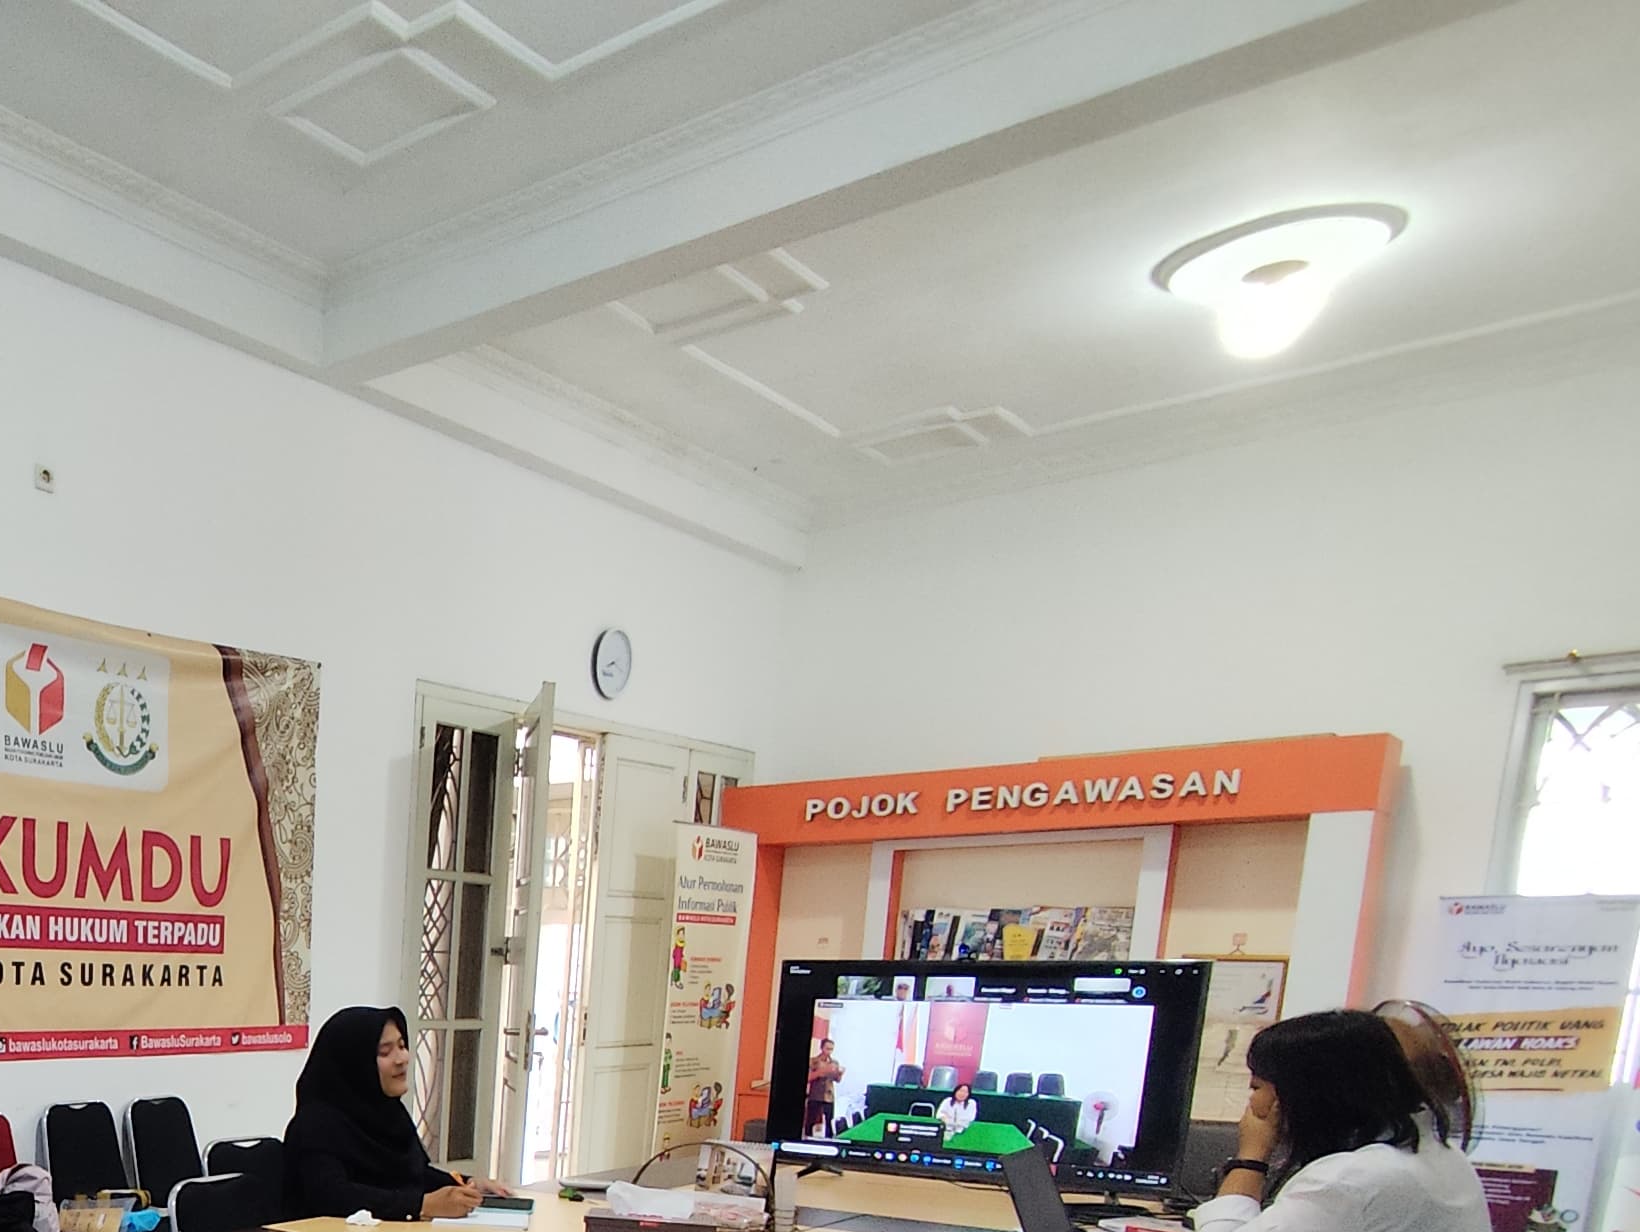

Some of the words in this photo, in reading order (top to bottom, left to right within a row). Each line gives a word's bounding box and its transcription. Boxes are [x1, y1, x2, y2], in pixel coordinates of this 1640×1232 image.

[4, 735, 64, 754] BAWASLU
[805, 791, 919, 822] POJOK
[946, 769, 1242, 814] PENGAWASAN
[48, 916, 128, 944] HUKUM
[134, 919, 221, 947] TERPADU
[60, 962, 223, 987] SURAKARTA
[1492, 1020, 1553, 1032] POLITIK
[9, 1037, 118, 1052] bawaslukotasurakarta
[141, 1034, 221, 1049] BawasluSurakarta
[1458, 1037, 1518, 1050] LAWAN
[1520, 1037, 1579, 1050] HOAKS
